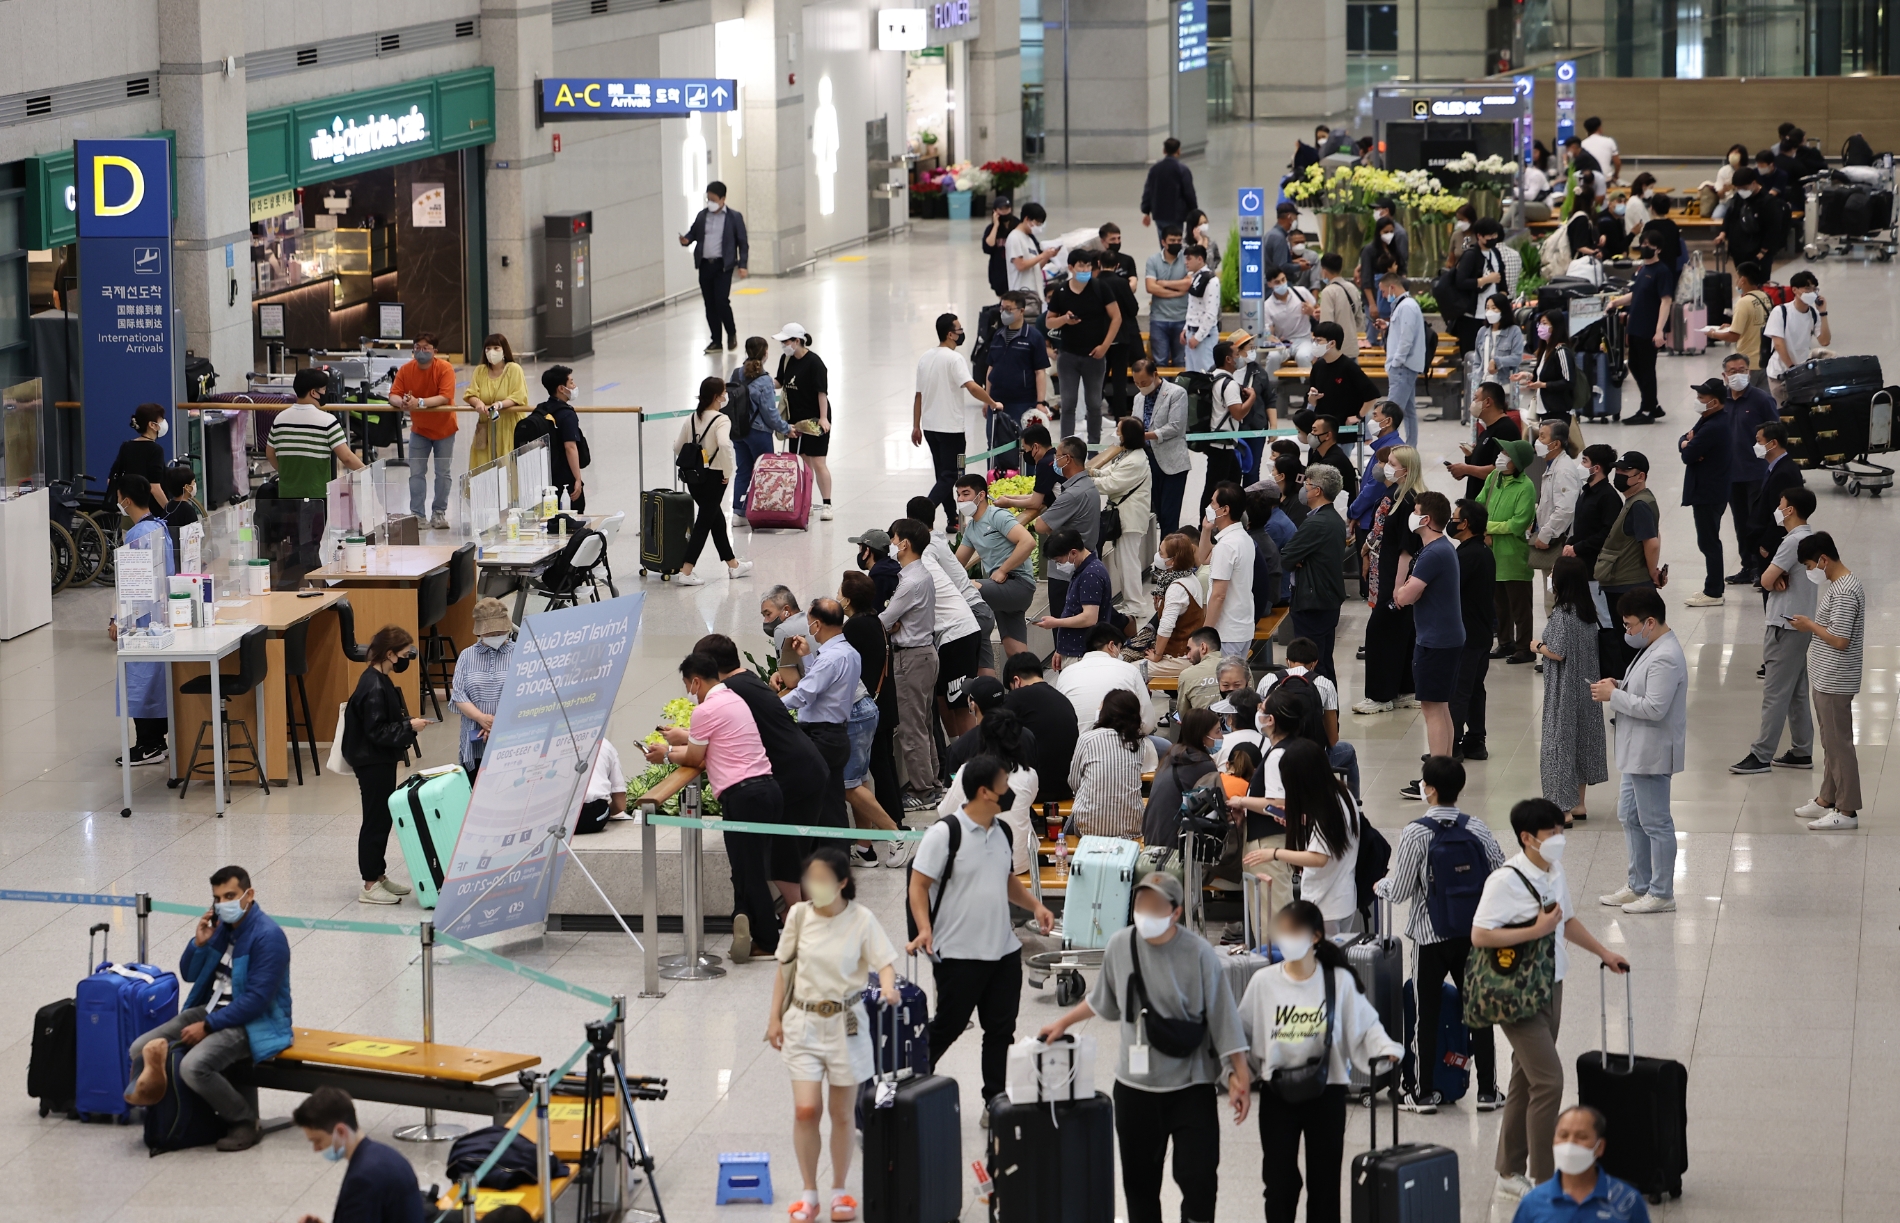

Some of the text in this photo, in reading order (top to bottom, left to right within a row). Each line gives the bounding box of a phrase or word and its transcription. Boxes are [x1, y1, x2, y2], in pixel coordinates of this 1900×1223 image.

[934, 0, 970, 28] FLOWER
[554, 83, 601, 107] A-C
[611, 96, 652, 109] Arrivals
[397, 104, 425, 144] cafe
[93, 155, 145, 217] D
[101, 285, 162, 299] 국제선도착
[98, 332, 164, 342] International
[126, 343, 164, 353] Arrivals
[1275, 998, 1328, 1028] Woody
